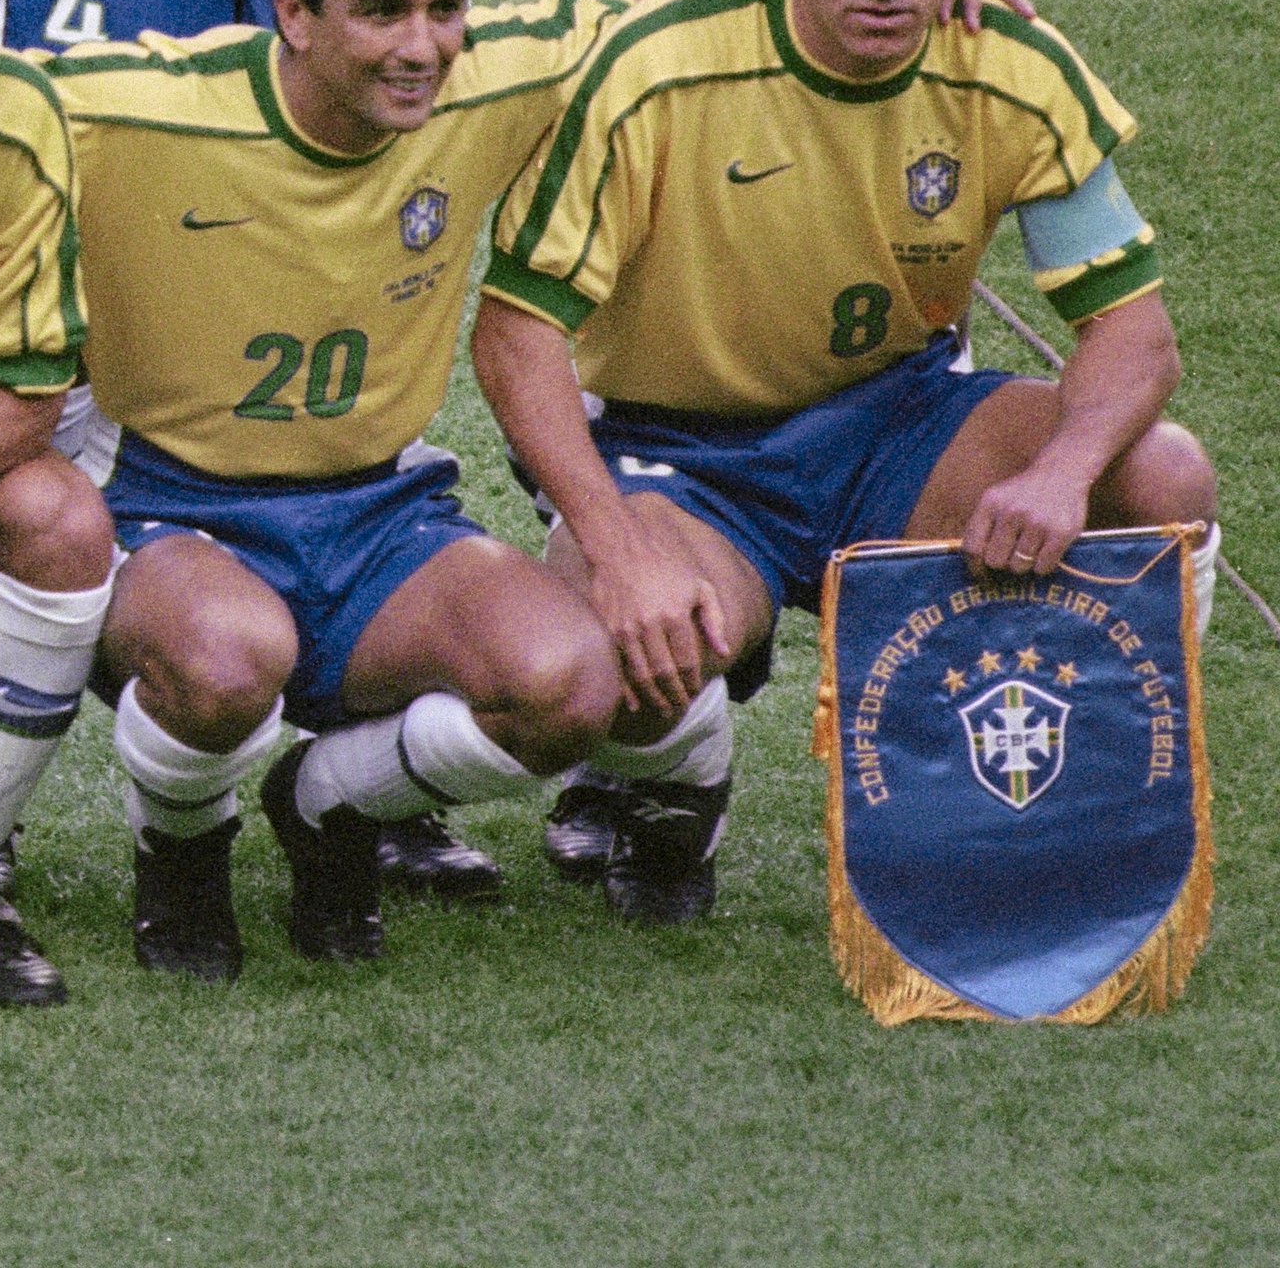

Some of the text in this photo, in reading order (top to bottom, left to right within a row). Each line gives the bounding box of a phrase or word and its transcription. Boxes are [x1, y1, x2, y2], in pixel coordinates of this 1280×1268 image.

[828, 282, 892, 358] 8
[232, 328, 369, 420] 20
[855, 583, 1175, 807] CONFEDERAÇÃO BRASILEIRA DE FUTEBOL
[995, 733, 1037, 749] CBF
